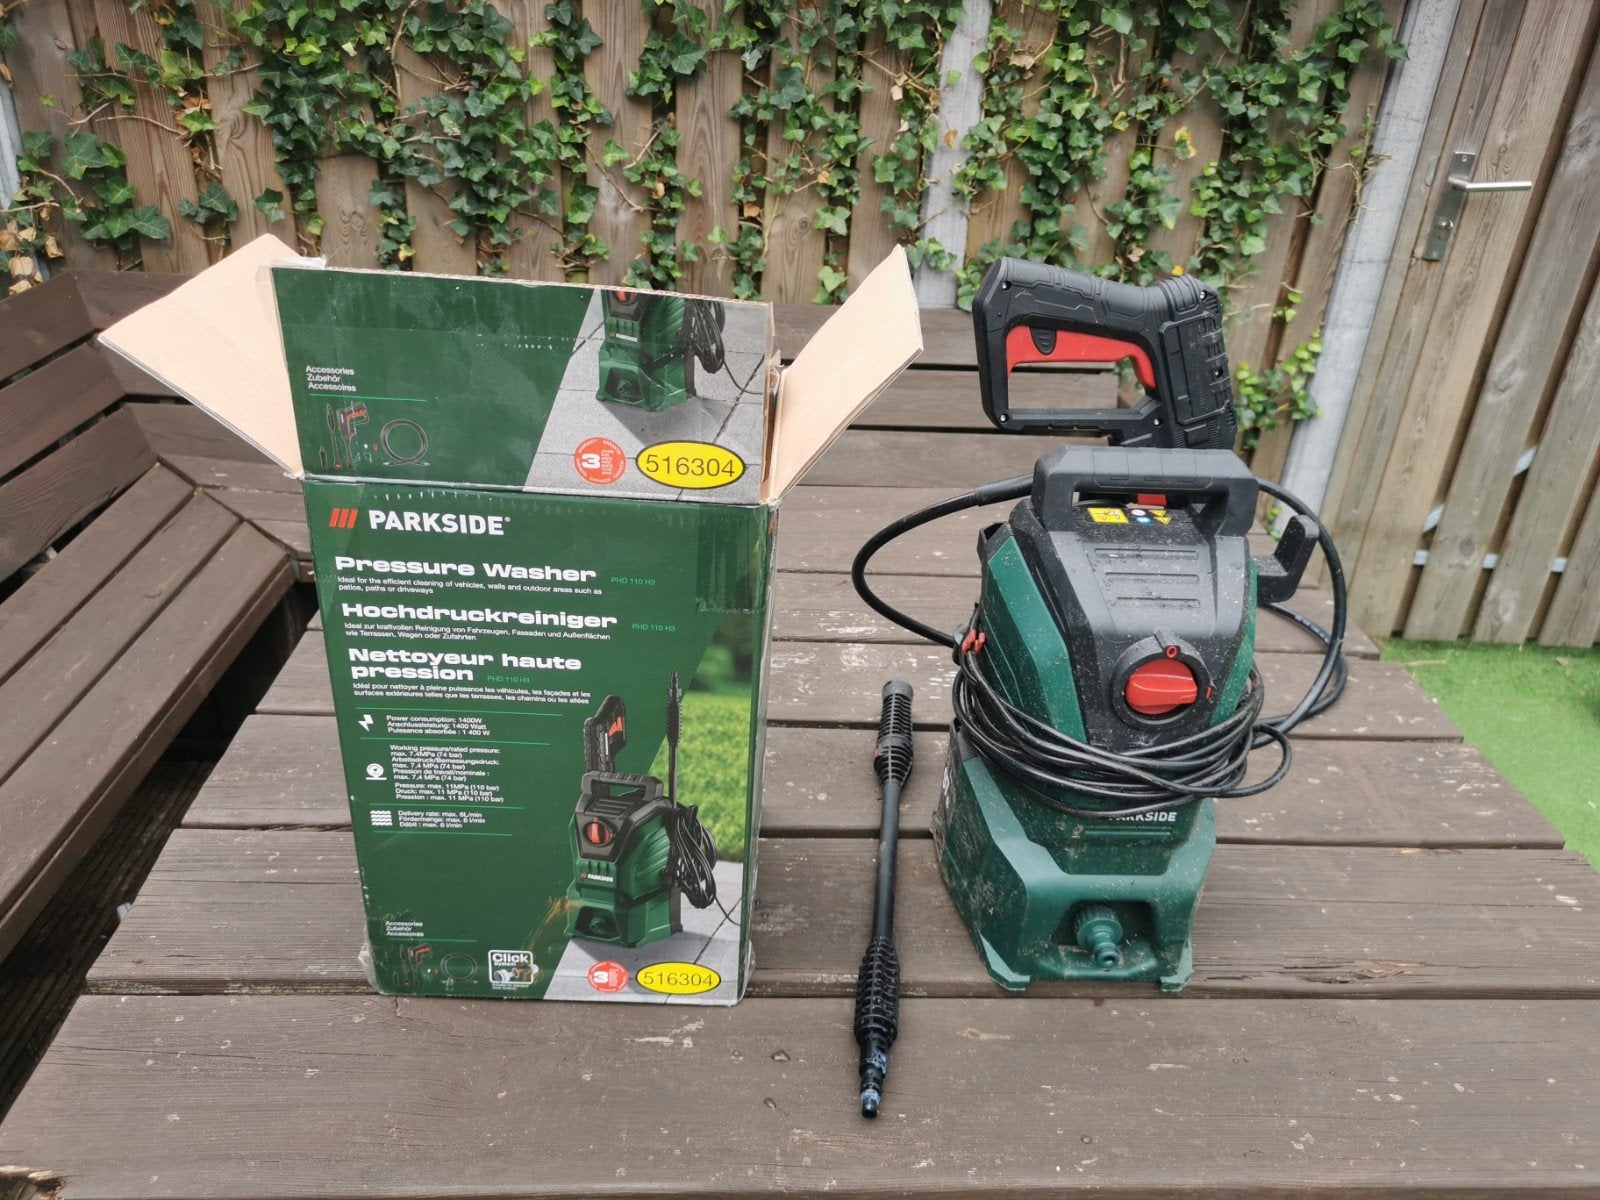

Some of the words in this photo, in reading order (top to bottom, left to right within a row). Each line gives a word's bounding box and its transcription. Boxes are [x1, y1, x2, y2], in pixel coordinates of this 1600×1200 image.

[306, 365, 354, 375] Accessories
[307, 374, 340, 382] Zubehör
[308, 382, 356, 391] Accessoires
[581, 453, 600, 468] 3
[646, 454, 735, 477] 516304
[369, 509, 504, 535] PARKSIDE
[335, 556, 475, 576] Pressure
[482, 563, 596, 582] Washer
[338, 584, 363, 592] patios,
[365, 585, 386, 593] paths
[397, 586, 433, 595] driveways
[413, 580, 443, 588] cleaning
[454, 582, 486, 590] vehicles,
[342, 603, 617, 629] Hochdruckreiniger
[360, 630, 396, 639] Terrassen,
[415, 625, 450, 634] Reinigung
[467, 628, 510, 636] Fahrzeugen,
[563, 632, 610, 640] Außenflächen
[348, 648, 494, 666] Nettoyeur
[502, 653, 581, 670] haute
[351, 666, 474, 680] pression
[389, 684, 418, 692] nettoyer
[426, 685, 447, 693] pleine
[448, 686, 483, 694] puissance
[496, 688, 531, 696] véhicules,
[544, 689, 570, 698] façades
[471, 694, 504, 702] terrasses,
[387, 721, 450, 730] Anschlussleistung:
[410, 716, 456, 724] consumption:
[420, 746, 468, 754] pressure/rated
[492, 953, 529, 963] Click
[593, 971, 608, 983] 3
[644, 972, 713, 986] 516304
